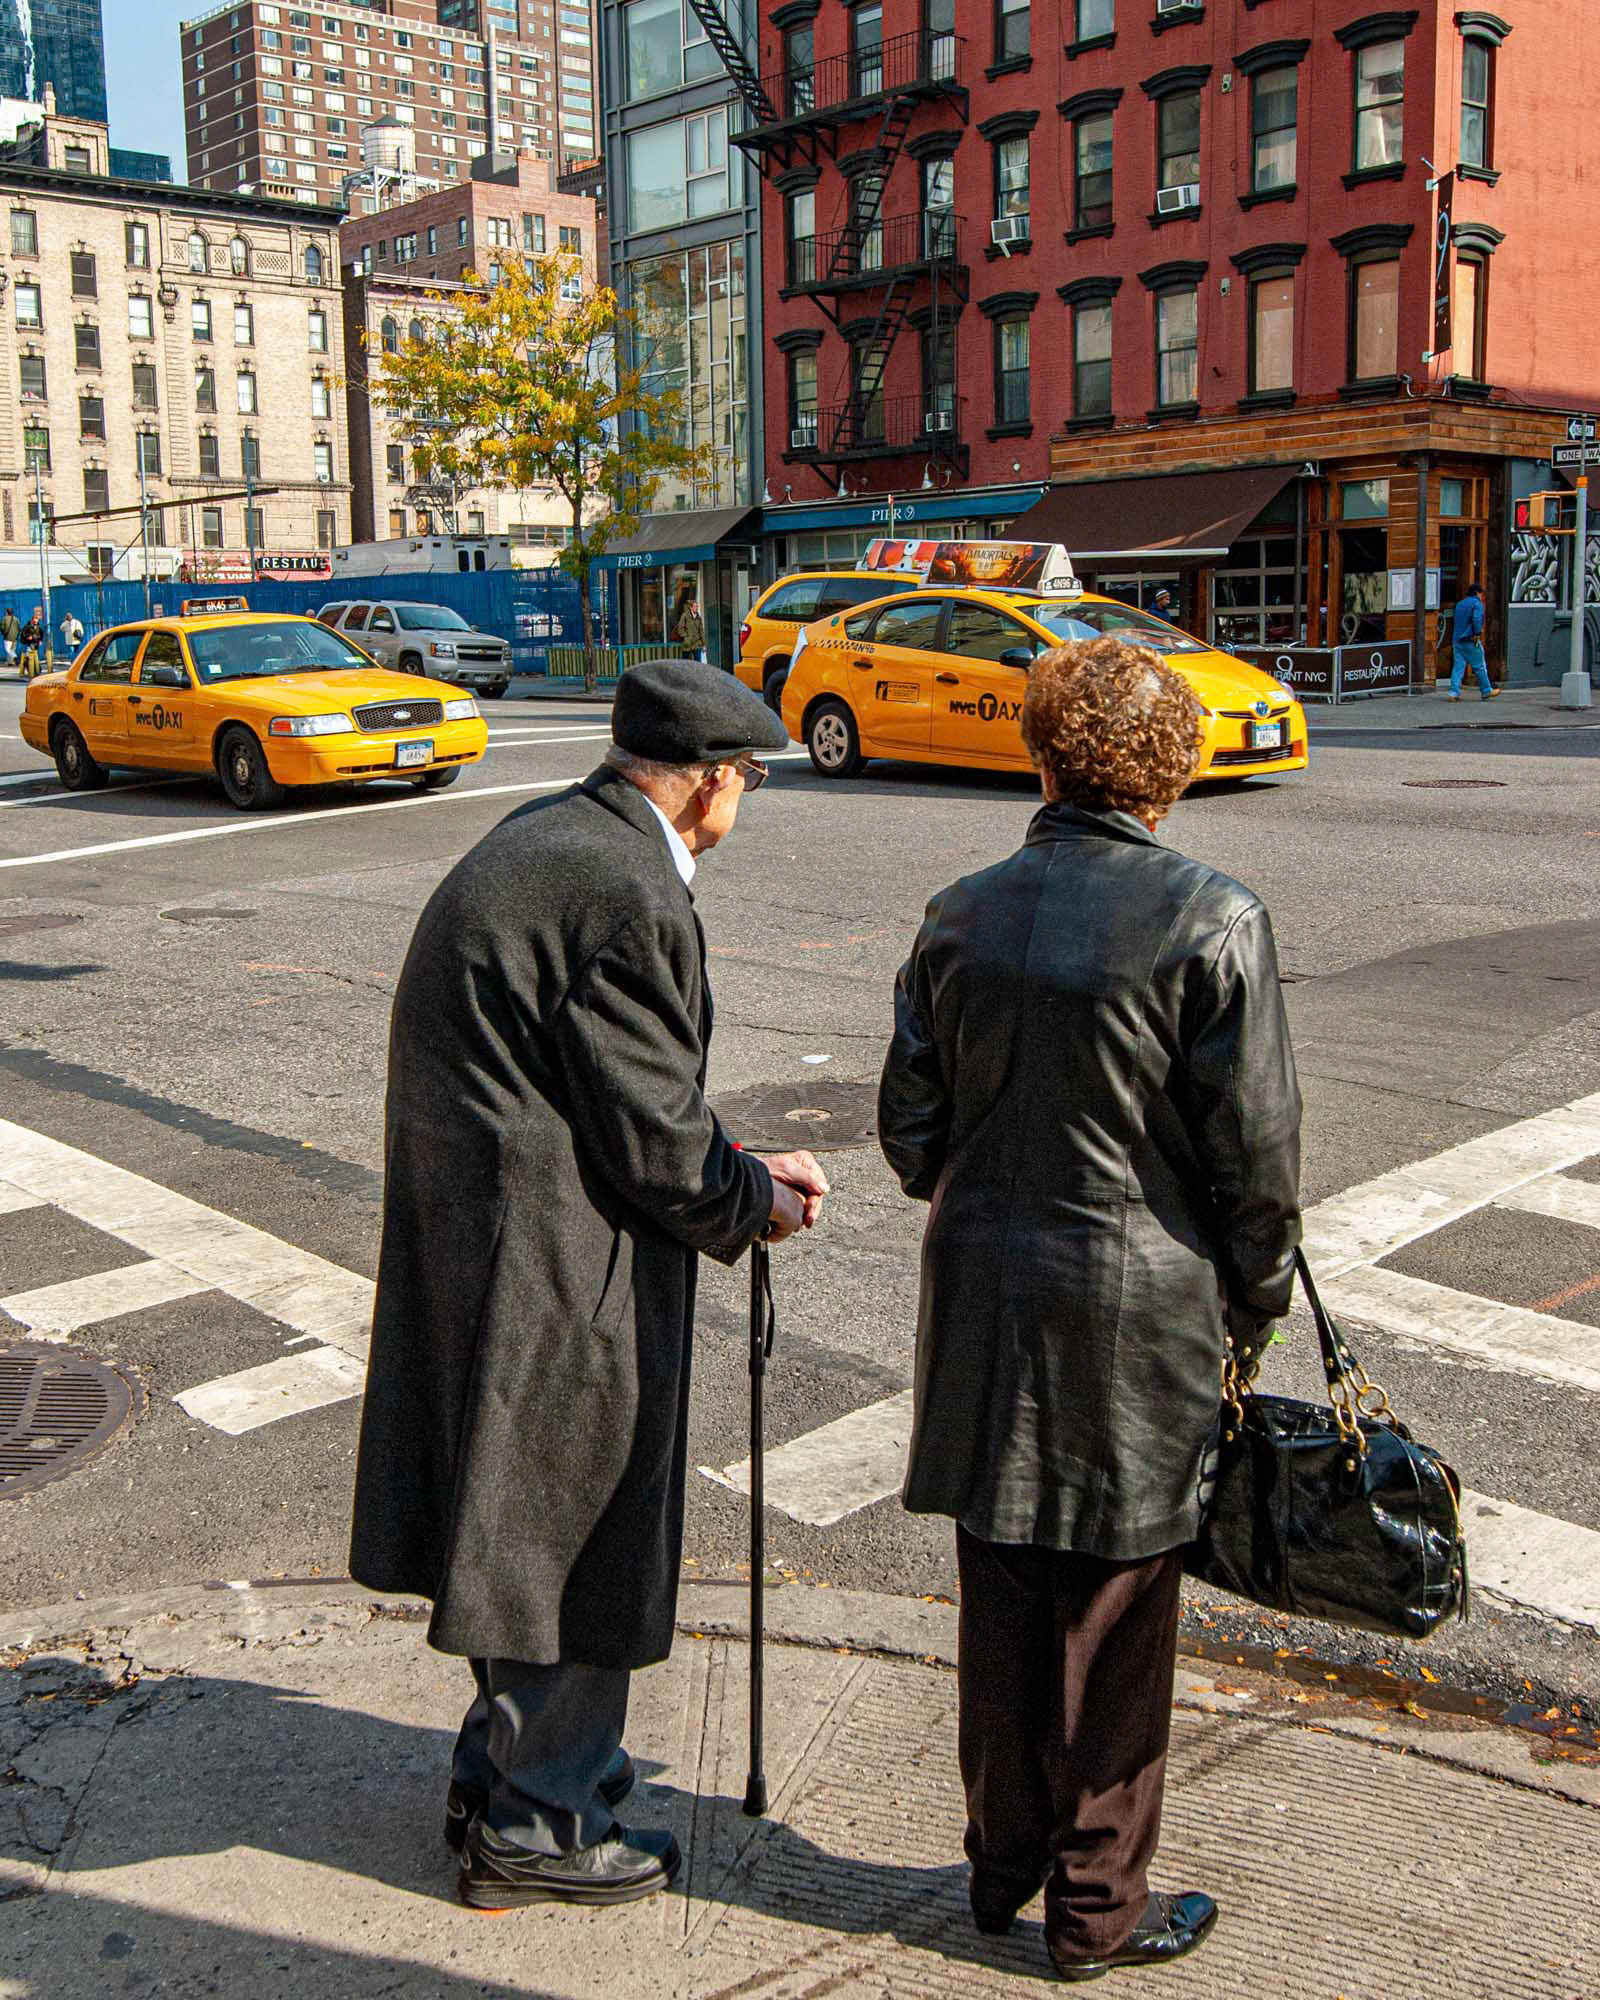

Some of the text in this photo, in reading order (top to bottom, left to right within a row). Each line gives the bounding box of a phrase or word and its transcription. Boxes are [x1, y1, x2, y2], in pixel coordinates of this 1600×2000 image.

[1561, 448, 1600, 460] ONE WA
[617, 555, 642, 567] PIER
[965, 549, 1014, 561] IMMORTALS
[1053, 578, 1072, 589] 4N96
[1304, 672, 1327, 683] NYC
[1344, 665, 1406, 681] RESTAURANT NYC
[949, 693, 1022, 721] NYC TAX
[135, 704, 182, 730] NYC TAXI
